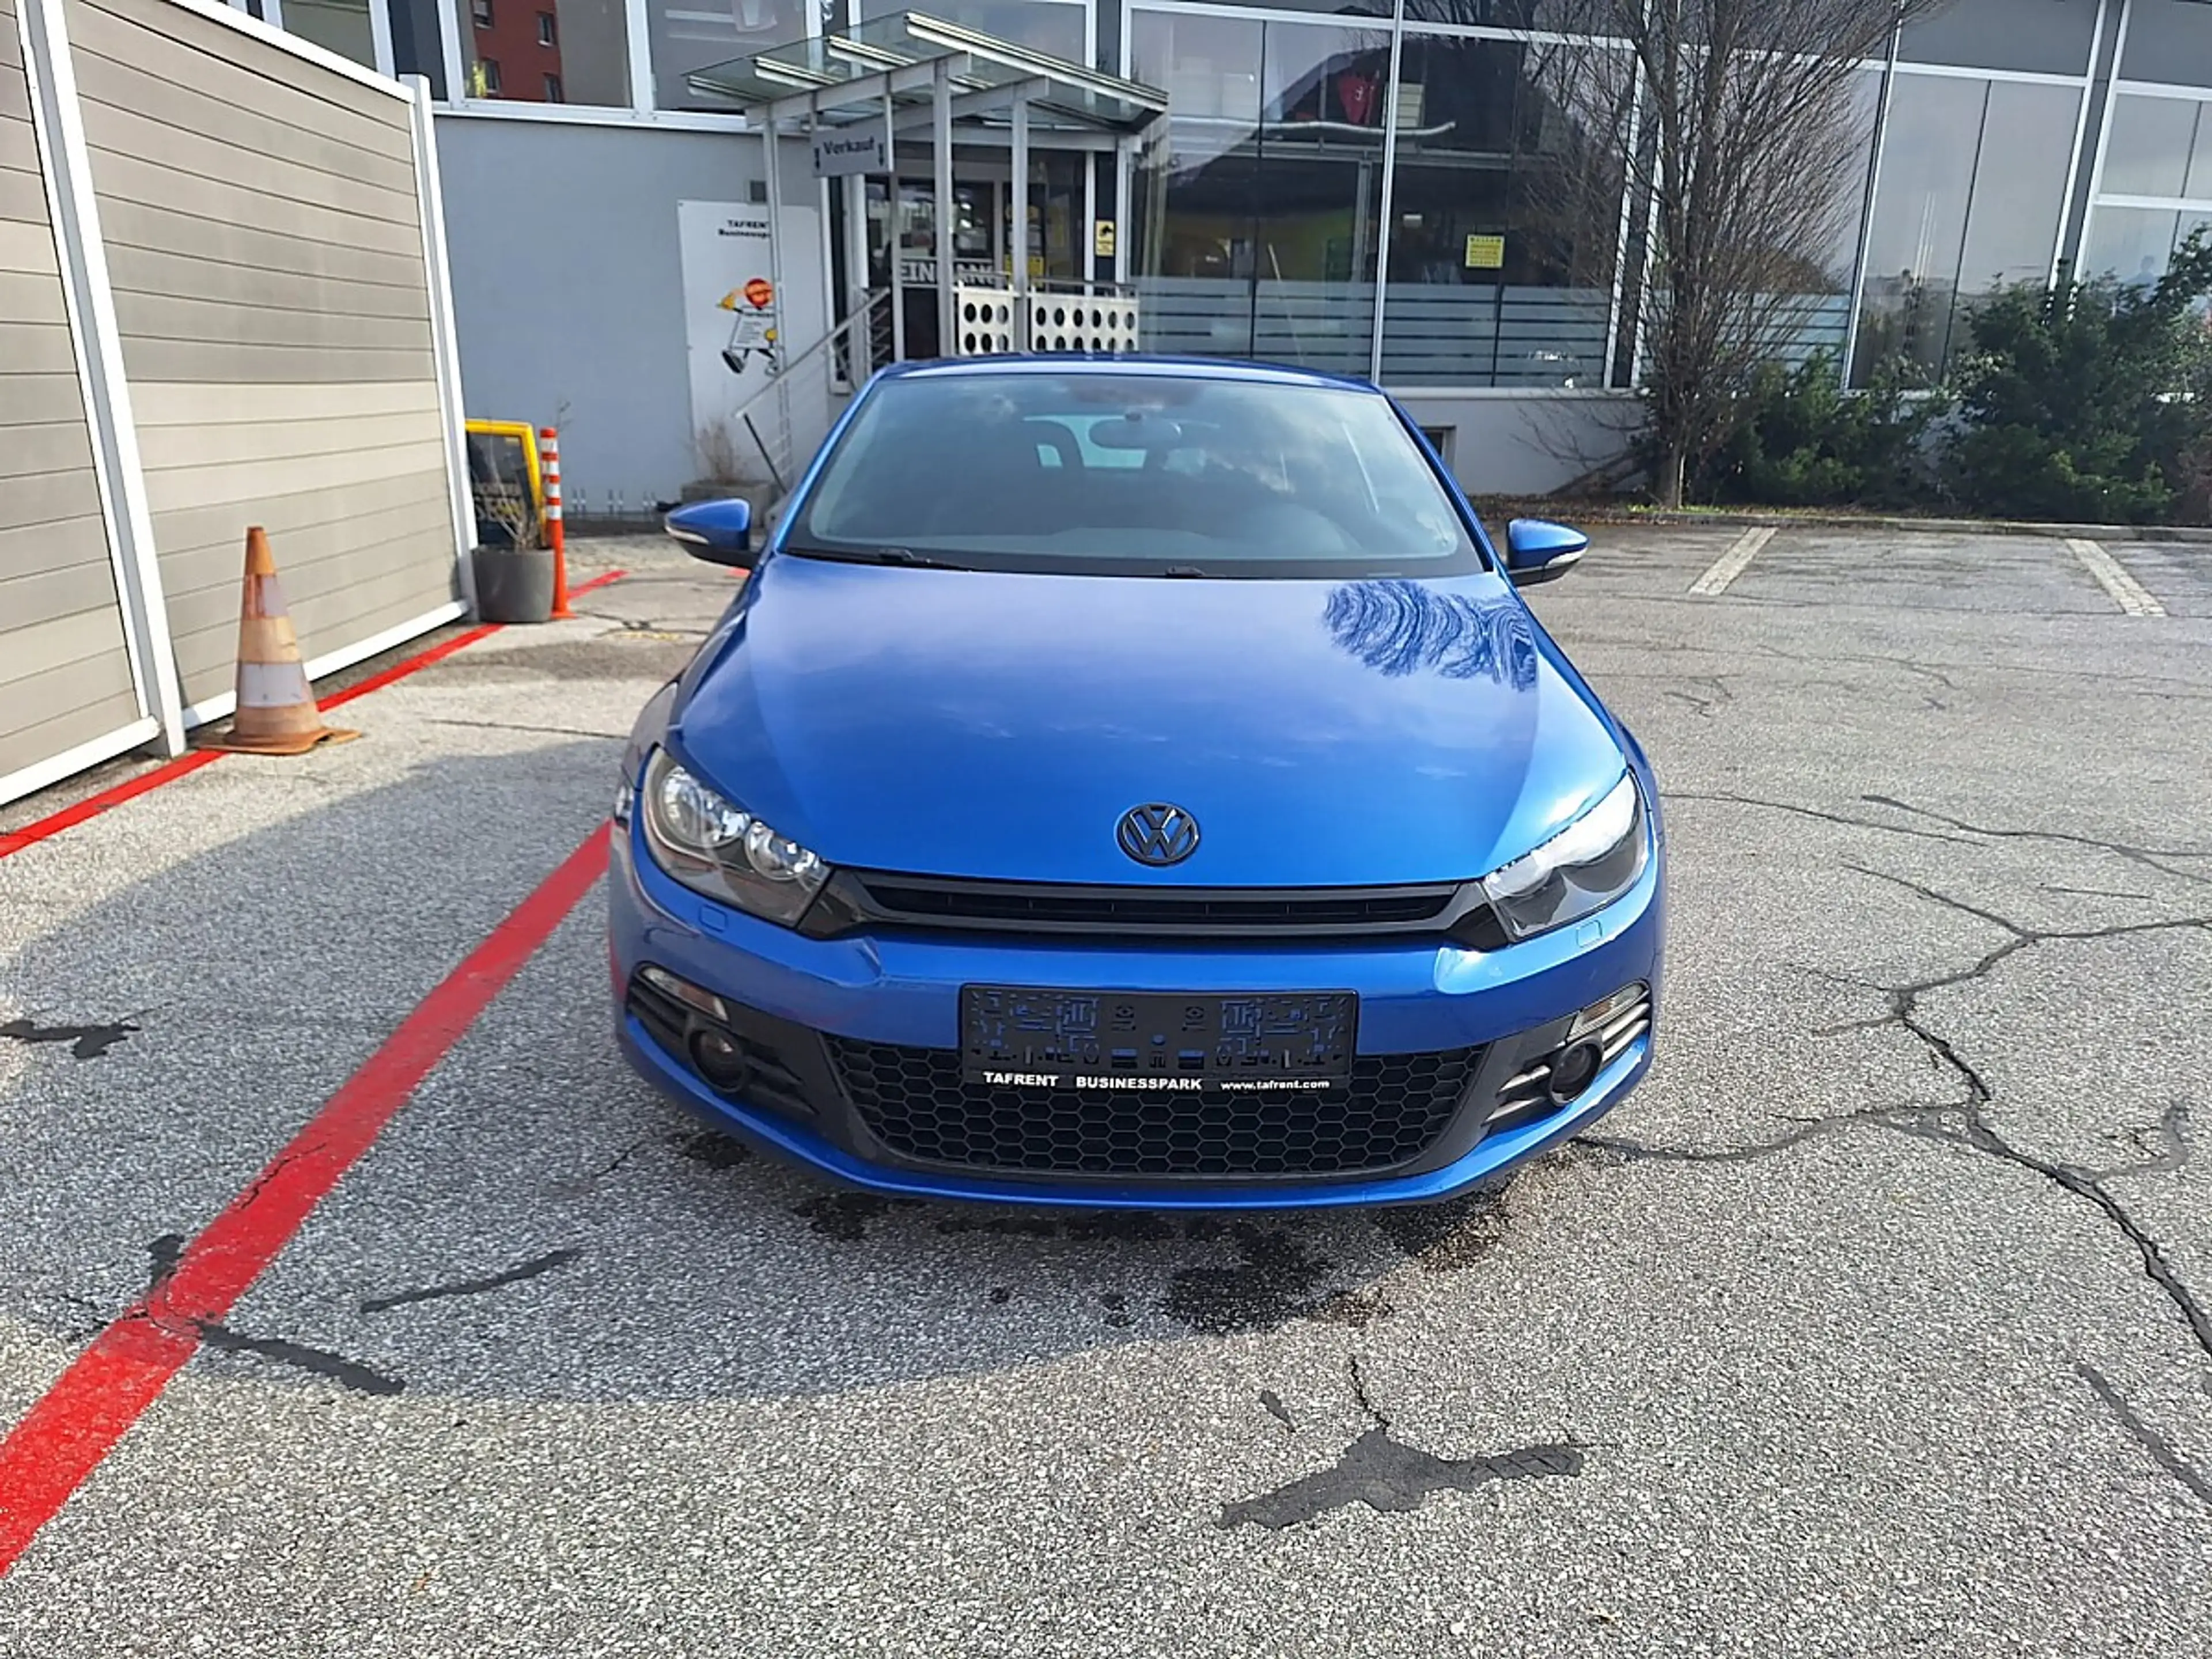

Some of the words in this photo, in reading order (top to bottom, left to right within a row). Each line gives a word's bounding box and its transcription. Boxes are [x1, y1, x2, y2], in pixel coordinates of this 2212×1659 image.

[823, 136, 875, 155] Verkauf
[1118, 803, 1196, 864] VW
[982, 1071, 1059, 1088] TAFRENT
[1075, 1076, 1203, 1090] BUSINESSPARK
[1220, 1080, 1330, 1091] www.tafrent.com
